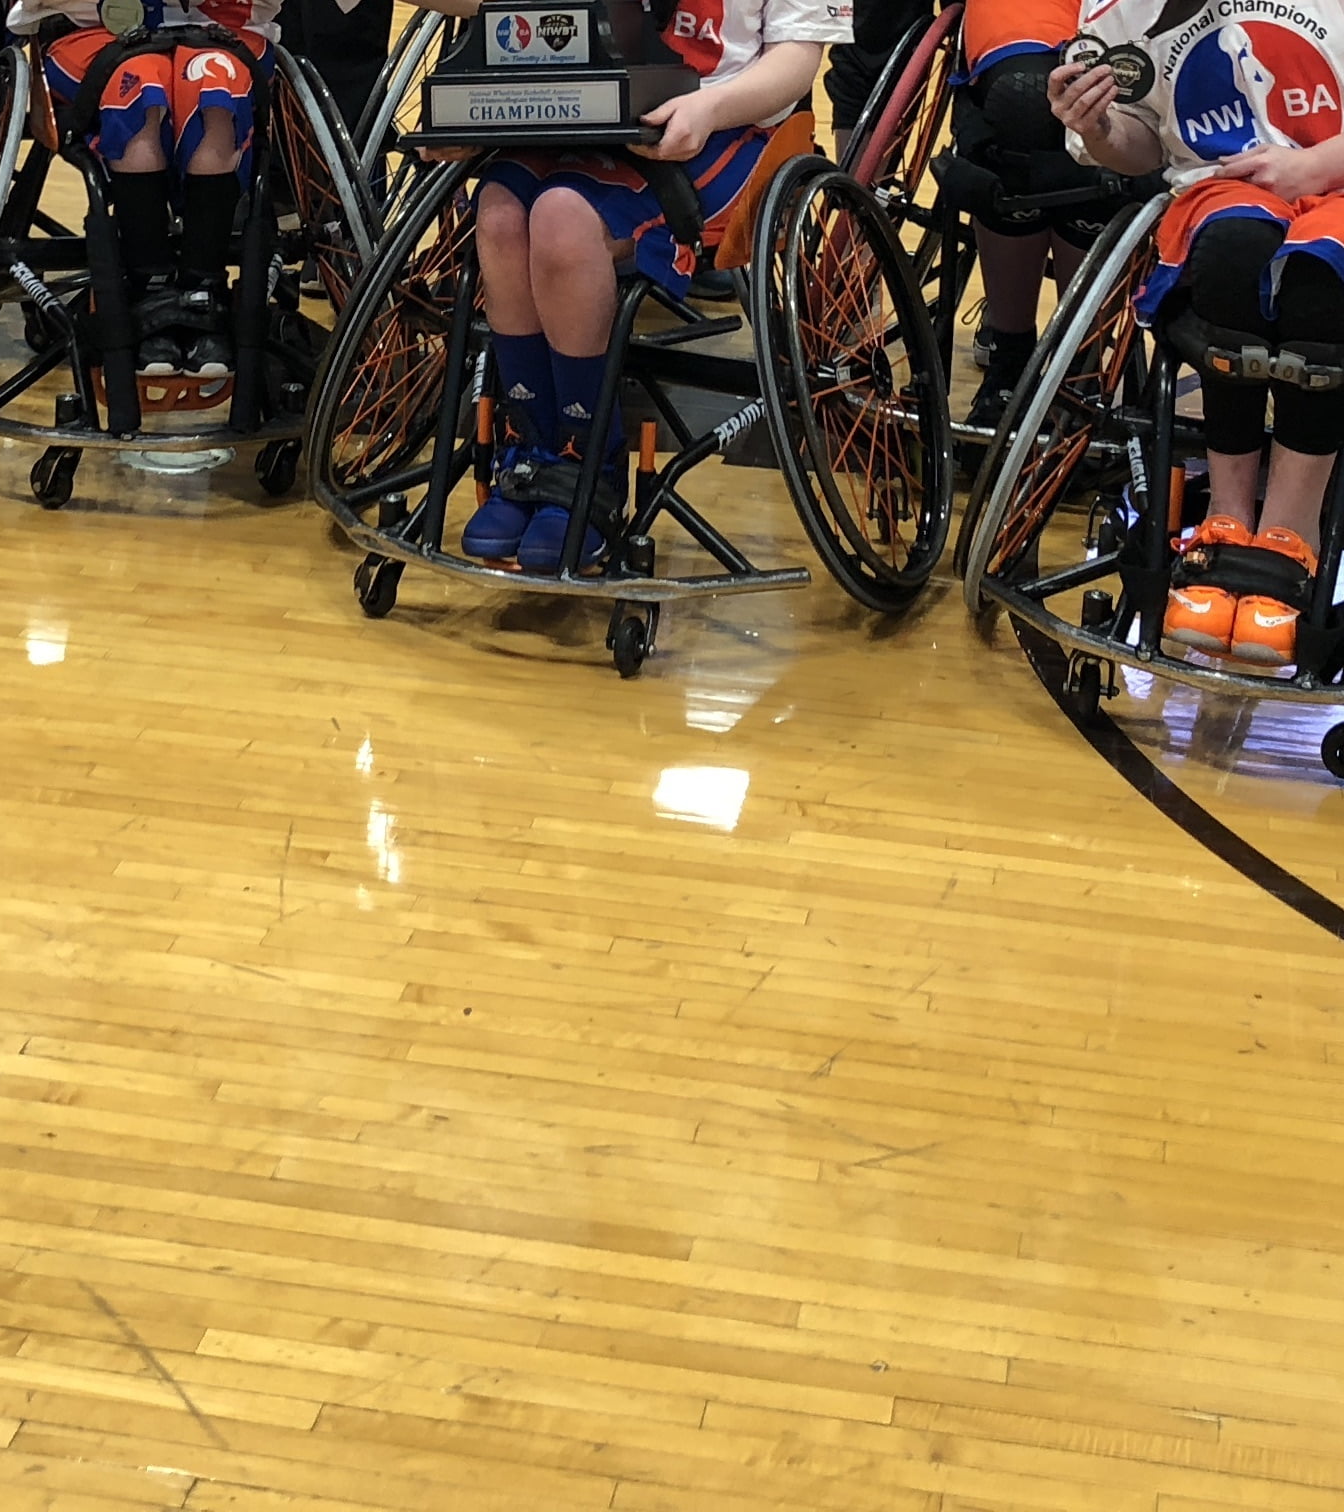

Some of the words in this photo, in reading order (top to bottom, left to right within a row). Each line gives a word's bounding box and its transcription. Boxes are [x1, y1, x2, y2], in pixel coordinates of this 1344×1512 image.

[537, 26, 577, 37] NIWBT
[674, 10, 721, 46] BA
[1164, 13, 1216, 83] National
[1218, 0, 1328, 41] Champions
[469, 104, 581, 121] CHAMPIONS
[1185, 100, 1244, 143] NW
[1282, 83, 1338, 118] BA
